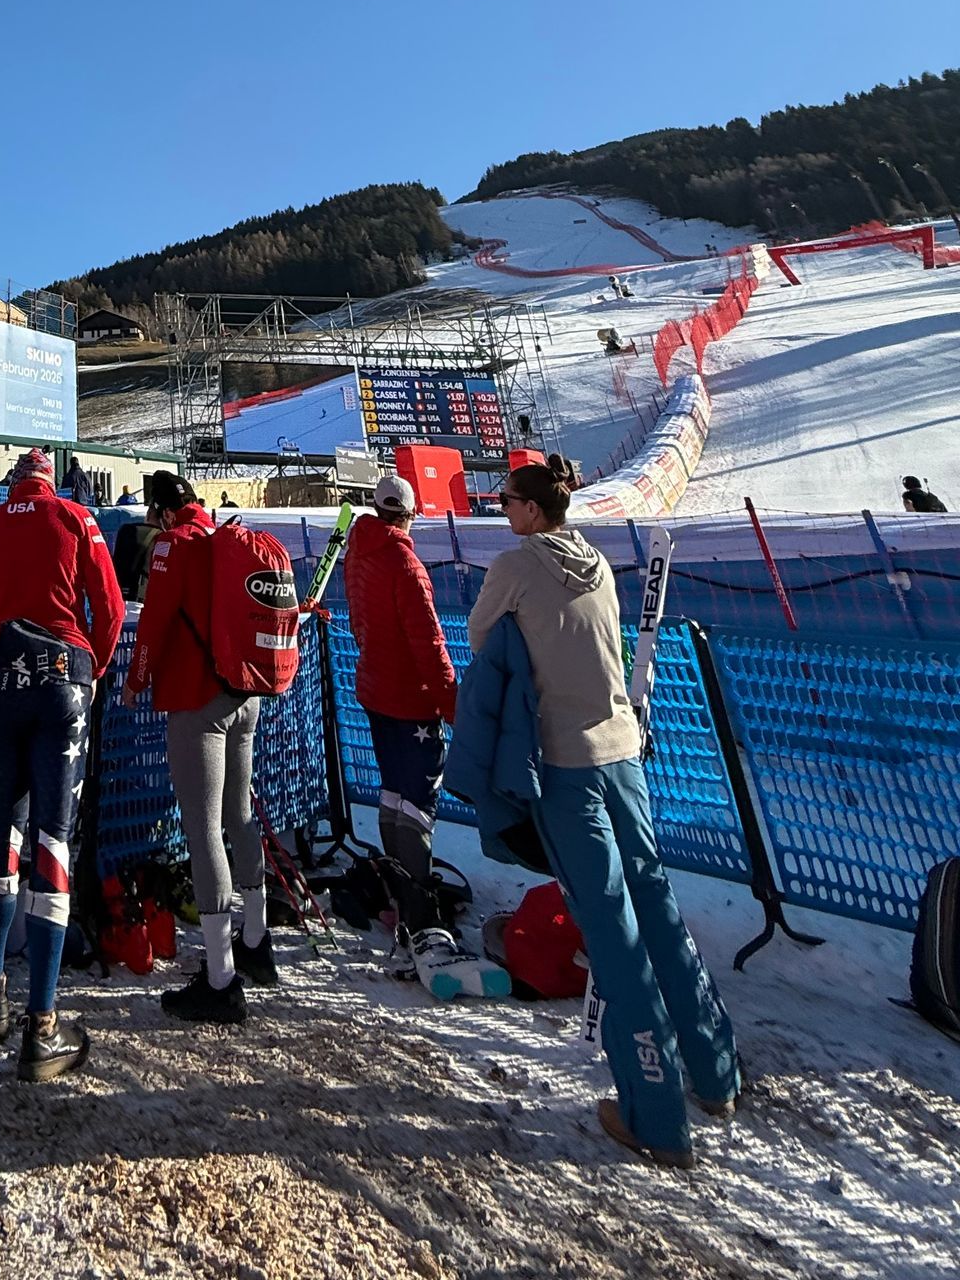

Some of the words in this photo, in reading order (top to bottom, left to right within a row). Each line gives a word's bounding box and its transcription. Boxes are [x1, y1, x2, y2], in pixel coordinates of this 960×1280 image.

[40, 368, 63, 385] 2026
[380, 369, 420, 378] LONGINES
[373, 380, 403, 388] SARRAZIN
[422, 381, 434, 389] FRA
[438, 381, 464, 390] 1:54.48
[375, 390, 398, 399] CASSE
[398, 391, 408, 399] M.
[424, 392, 436, 400] ITA
[446, 392, 465, 401] +1.07
[477, 393, 497, 402] +0.29
[42, 397, 55, 408] THU
[376, 401, 405, 410] MONNEY
[406, 402, 414, 411] A.
[426, 403, 437, 411] SUI
[448, 403, 467, 412] +1.17
[23, 407, 36, 416] and
[479, 404, 499, 413] +0.44
[427, 414, 441, 422] USA
[450, 414, 470, 423] +1.28
[481, 415, 500, 424] +1.74
[31, 418, 49, 430] Sprint
[49, 421, 63, 432] Final
[379, 424, 418, 433] INNERHOFER
[430, 425, 442, 433] ITA
[452, 425, 472, 435] +1.41
[483, 426, 503, 435] +2.74
[369, 436, 391, 444] SPEED
[485, 438, 505, 447] +2.95
[382, 447, 396, 455] ZA
[463, 449, 475, 457] ITA
[481, 449, 504, 458] 1:48.9
[7, 501, 36, 514] USA
[640, 556, 665, 633] HEAD
[632, 1029, 665, 1084] USA
